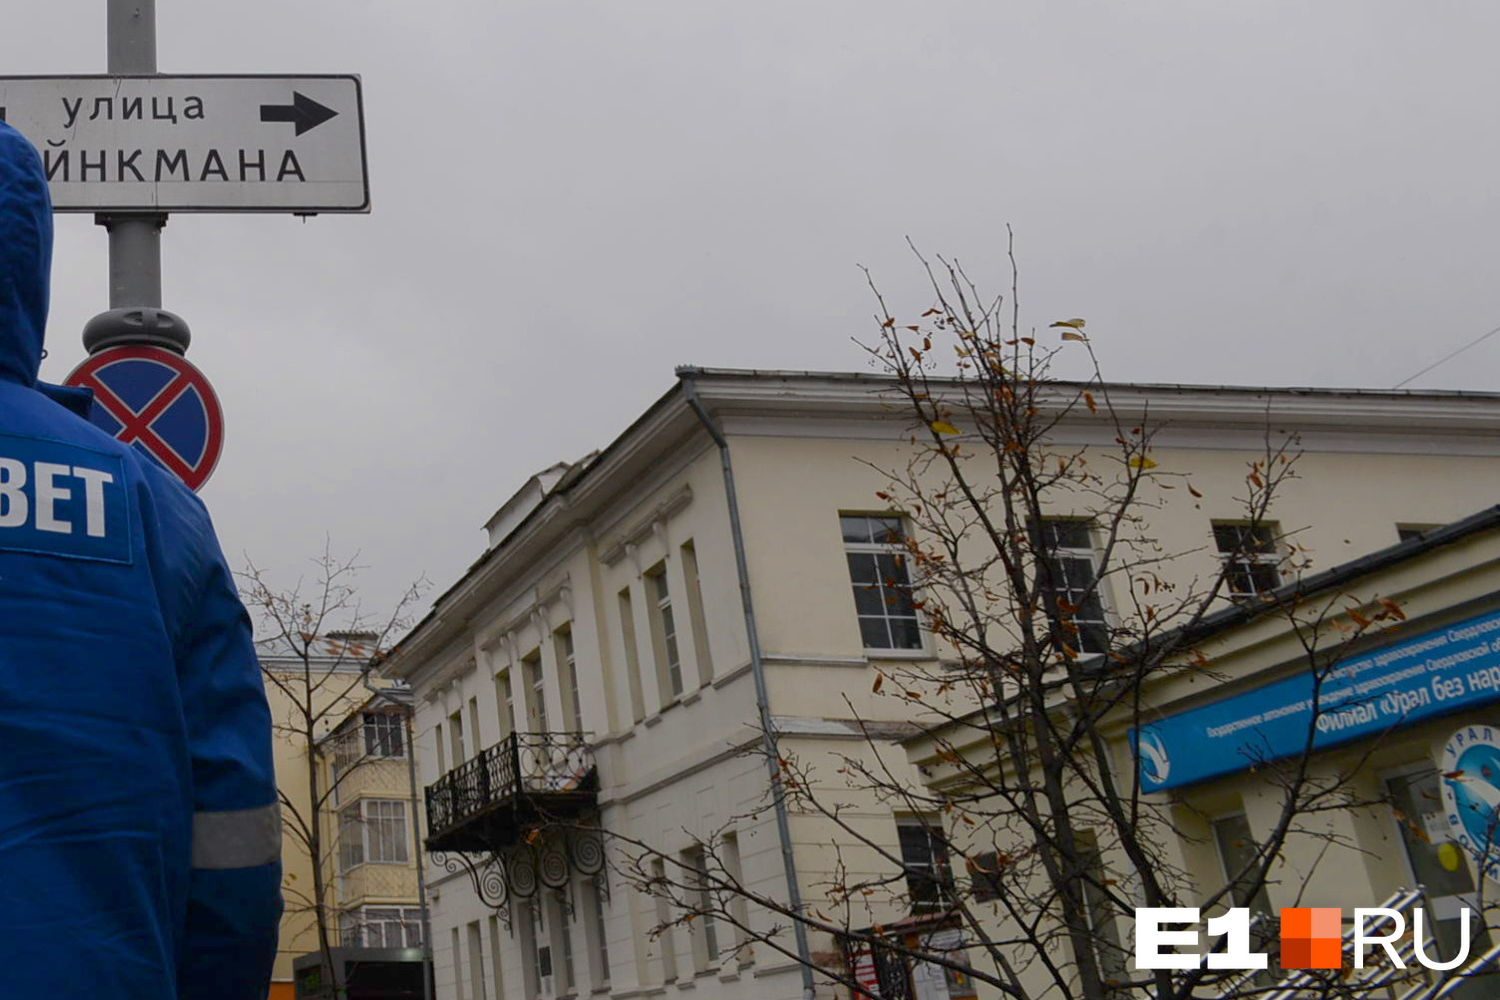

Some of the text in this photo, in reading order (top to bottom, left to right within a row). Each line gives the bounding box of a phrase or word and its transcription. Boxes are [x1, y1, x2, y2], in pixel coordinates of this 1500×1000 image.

[61, 95, 205, 129] улица
[1316, 702, 1378, 734] Филиал
[1432, 675, 1464, 701] без
[1446, 727, 1493, 757] УРАЛ
